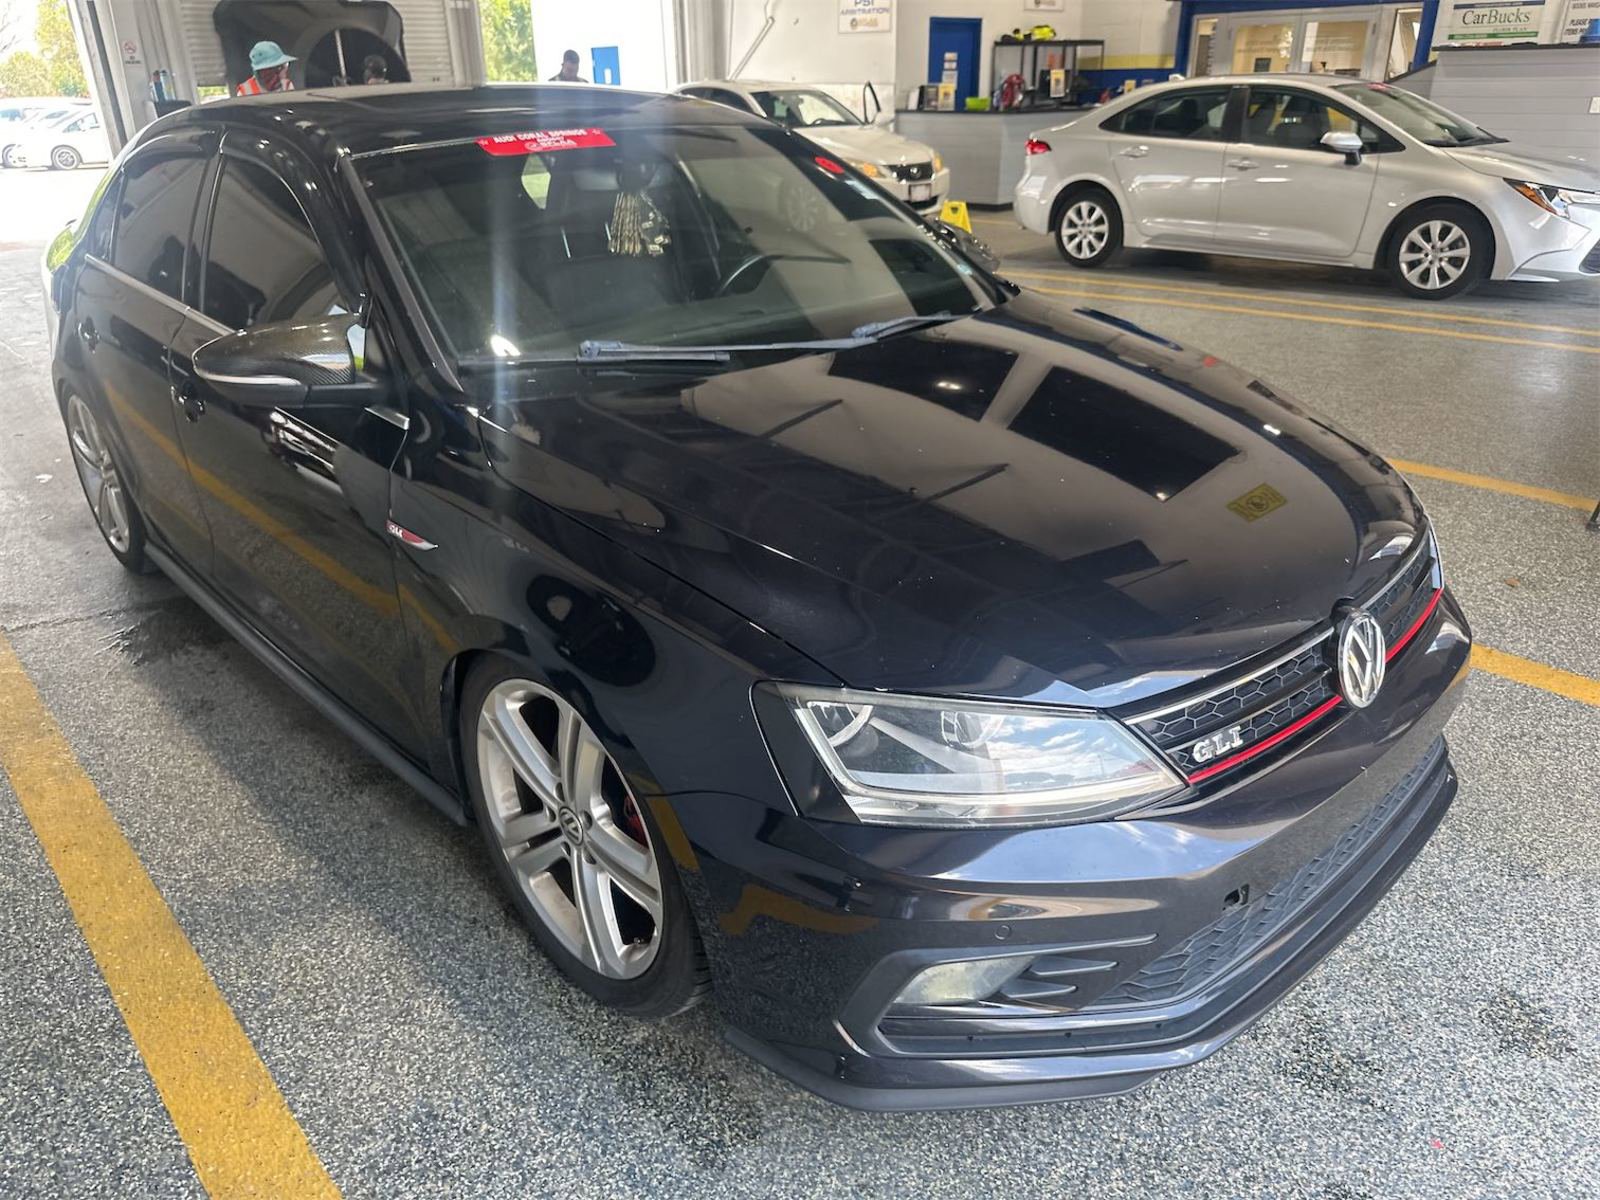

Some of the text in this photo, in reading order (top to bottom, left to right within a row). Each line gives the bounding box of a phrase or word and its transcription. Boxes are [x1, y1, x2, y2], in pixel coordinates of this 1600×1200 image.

[1462, 8, 1531, 25] CarBucks
[494, 135, 517, 144] AUDI
[517, 131, 549, 141] CORAL
[1193, 726, 1244, 763] GLI
